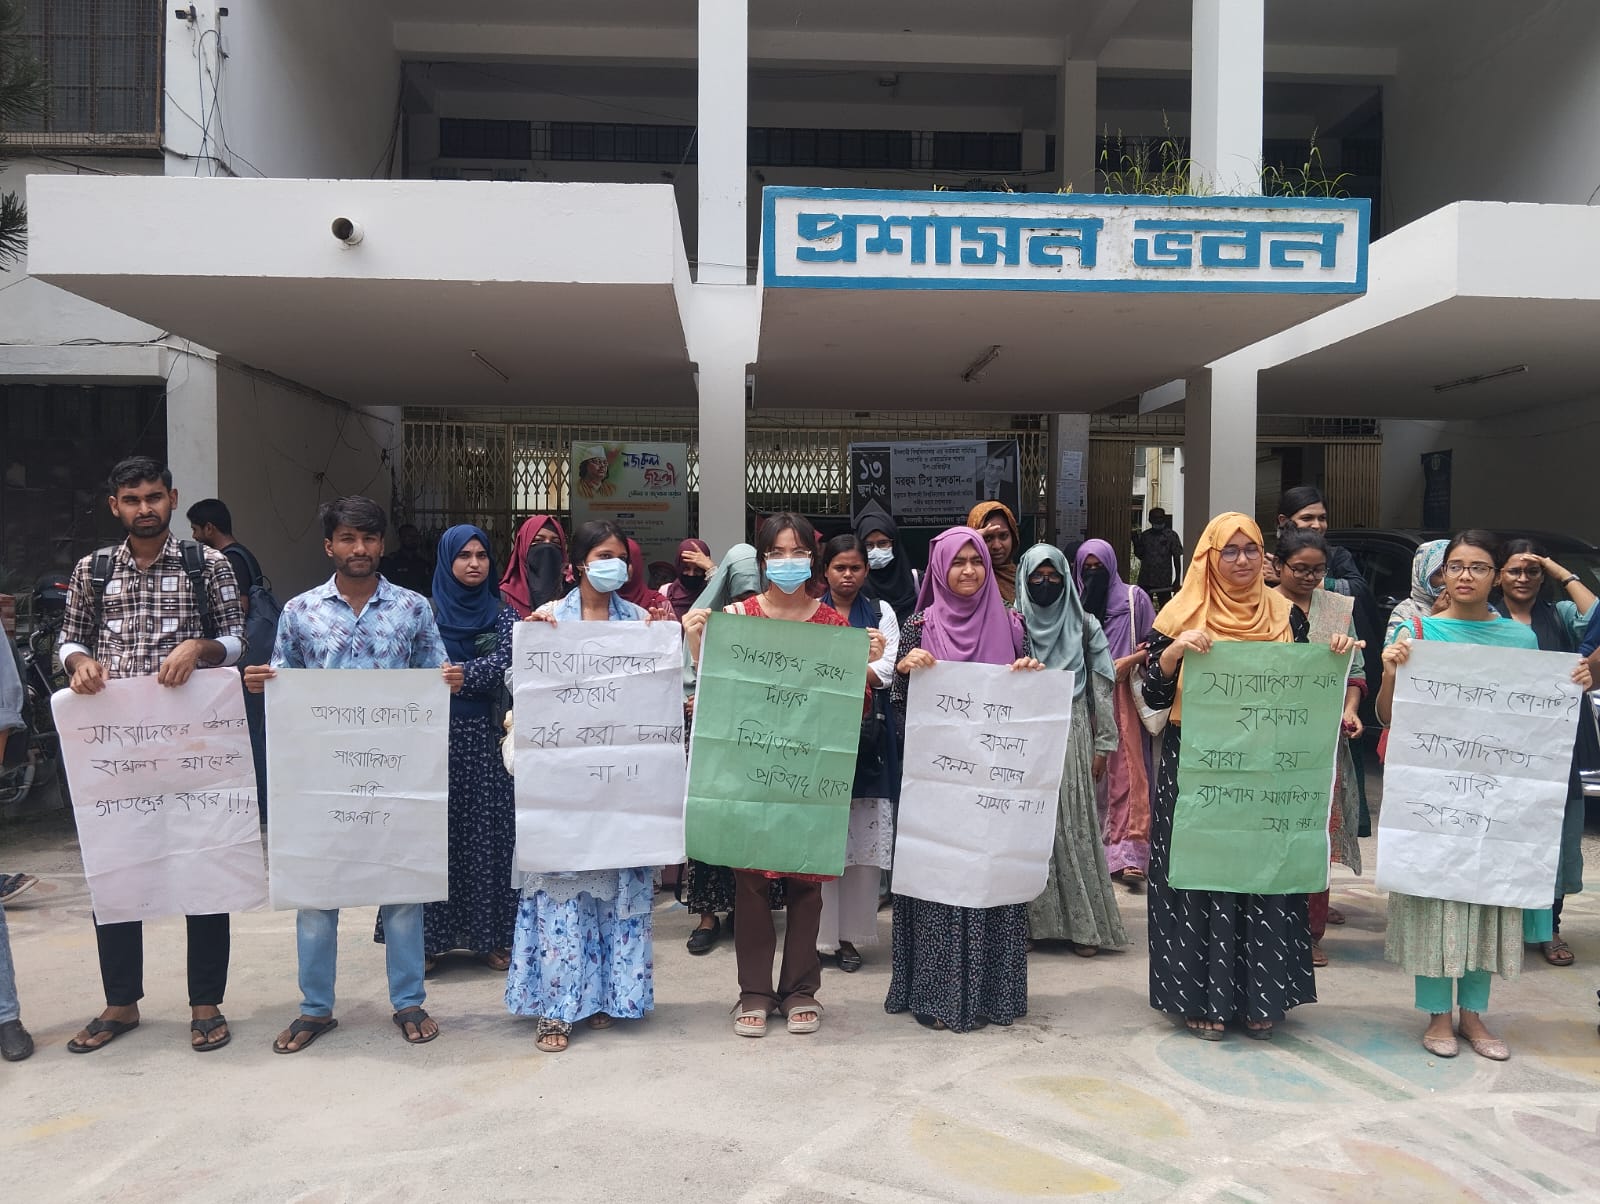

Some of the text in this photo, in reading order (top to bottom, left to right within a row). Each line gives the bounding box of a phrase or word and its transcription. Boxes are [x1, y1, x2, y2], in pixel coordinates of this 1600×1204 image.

[796, 213, 1344, 269] প্রশাসন ভবন
[859, 459, 883, 480] ১৩
[524, 640, 662, 675] সাংবাদিকদের
[1236, 707, 1309, 732] হামলার
[576, 724, 627, 746] করা
[333, 747, 407, 772] সাংবাদিকতা
[1411, 732, 1553, 768] সাংবাদিকতা
[91, 751, 243, 777] হামলা মানেই
[587, 765, 616, 784] না
[349, 781, 385, 798] নাকি
[818, 777, 849, 800] হোক
[1444, 774, 1503, 799] নাকি
[175, 792, 221, 812] কবর
